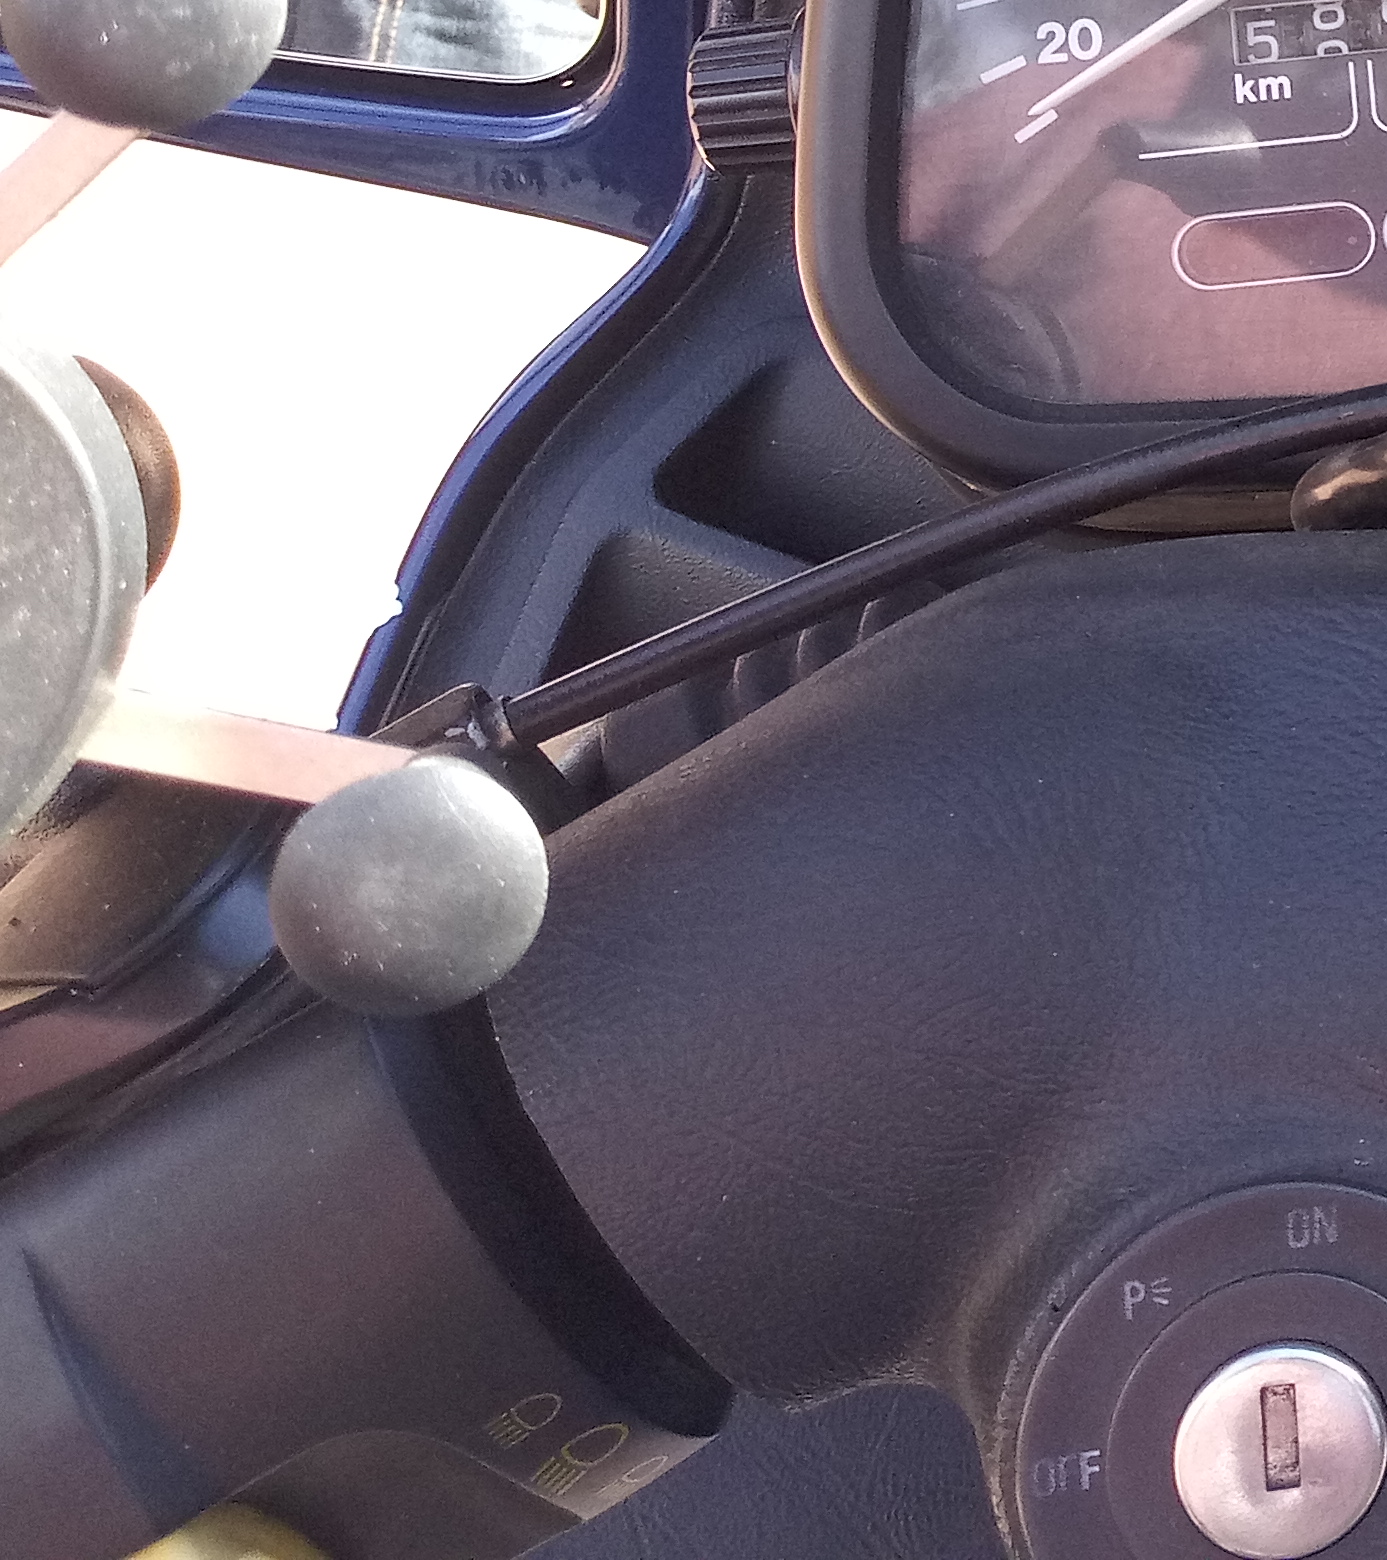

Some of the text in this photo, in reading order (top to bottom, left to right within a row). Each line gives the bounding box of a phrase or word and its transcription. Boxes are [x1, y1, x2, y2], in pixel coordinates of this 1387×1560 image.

[1036, 15, 1103, 65] 20
[1234, 72, 1292, 104] km
[1286, 1205, 1338, 1250] ON
